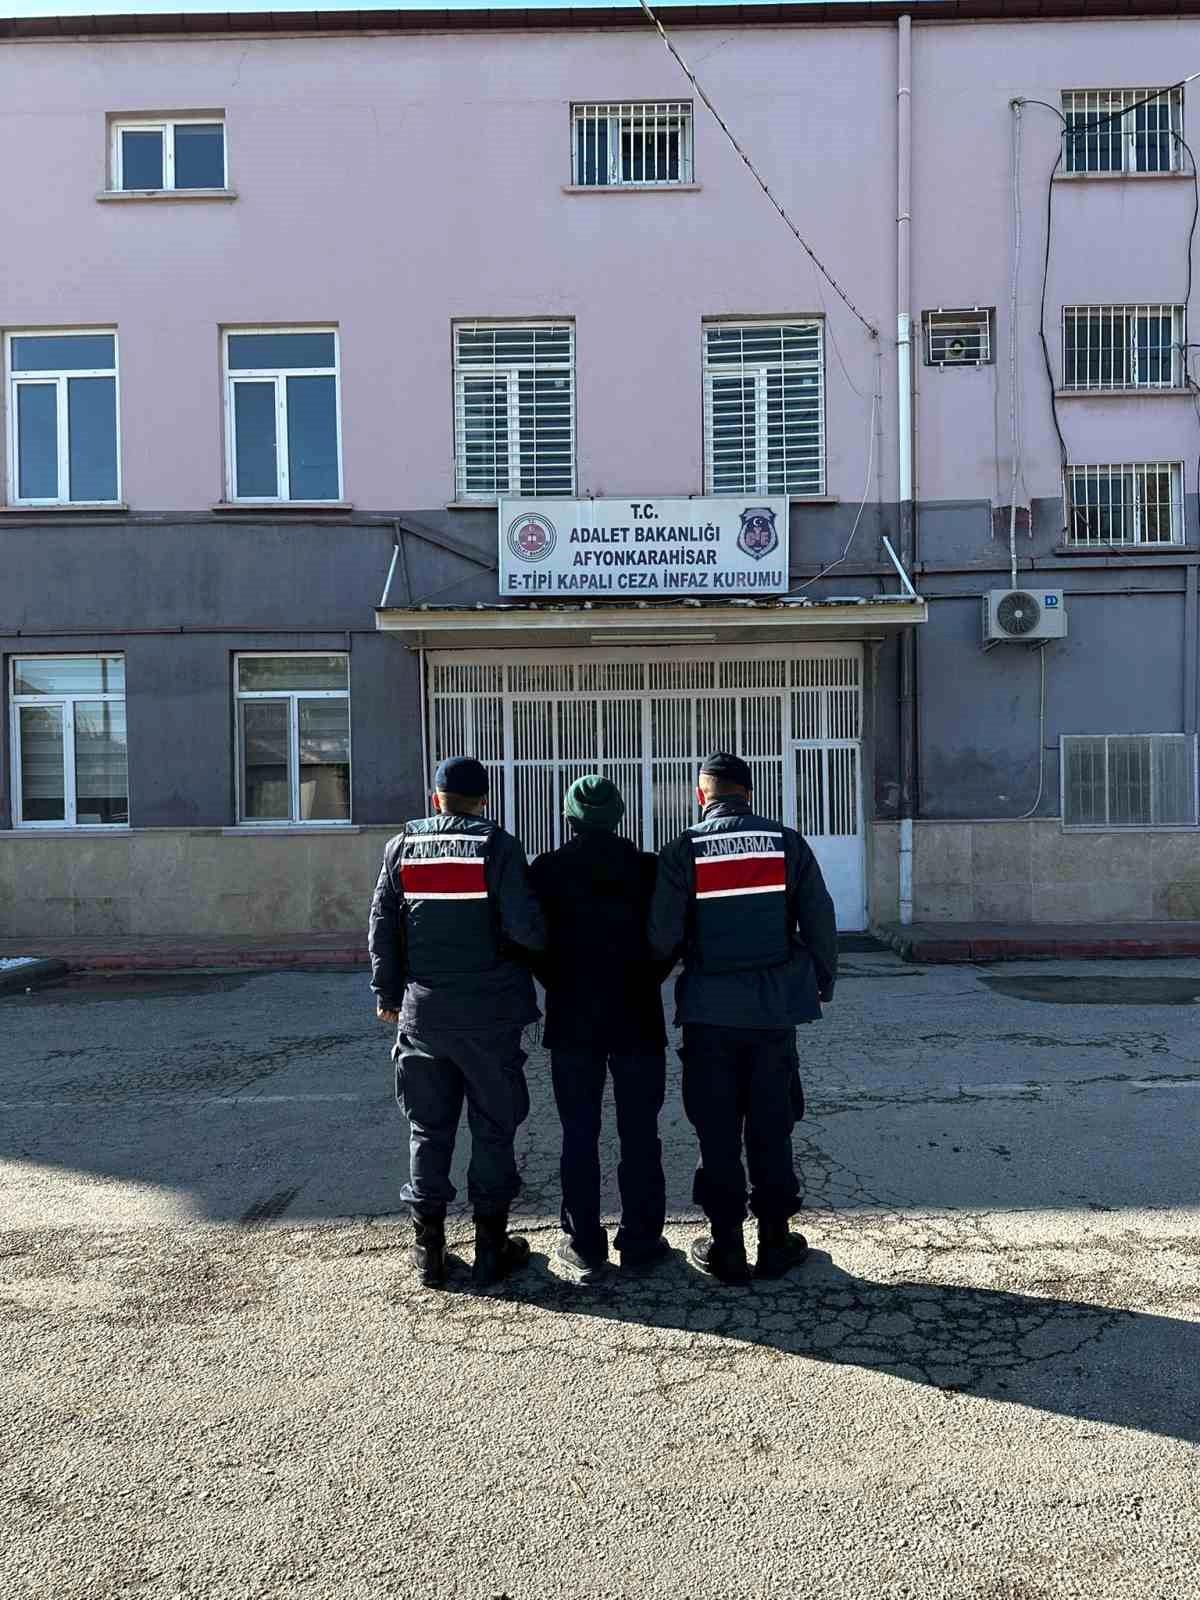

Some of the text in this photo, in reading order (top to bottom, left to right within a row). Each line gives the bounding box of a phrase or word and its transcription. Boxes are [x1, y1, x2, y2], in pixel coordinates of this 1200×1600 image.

[630, 503, 659, 519] T.C.
[570, 527, 630, 543] ADALET
[635, 522, 720, 542] BAKANLIĞI
[573, 546, 717, 566] AFYONKARAHİSAR
[508, 569, 782, 590] E-TİPİ KAPALI CEZA İNFAZ KURUMU
[408, 839, 477, 858] JANDARMA
[703, 837, 775, 857] JANDARMA
